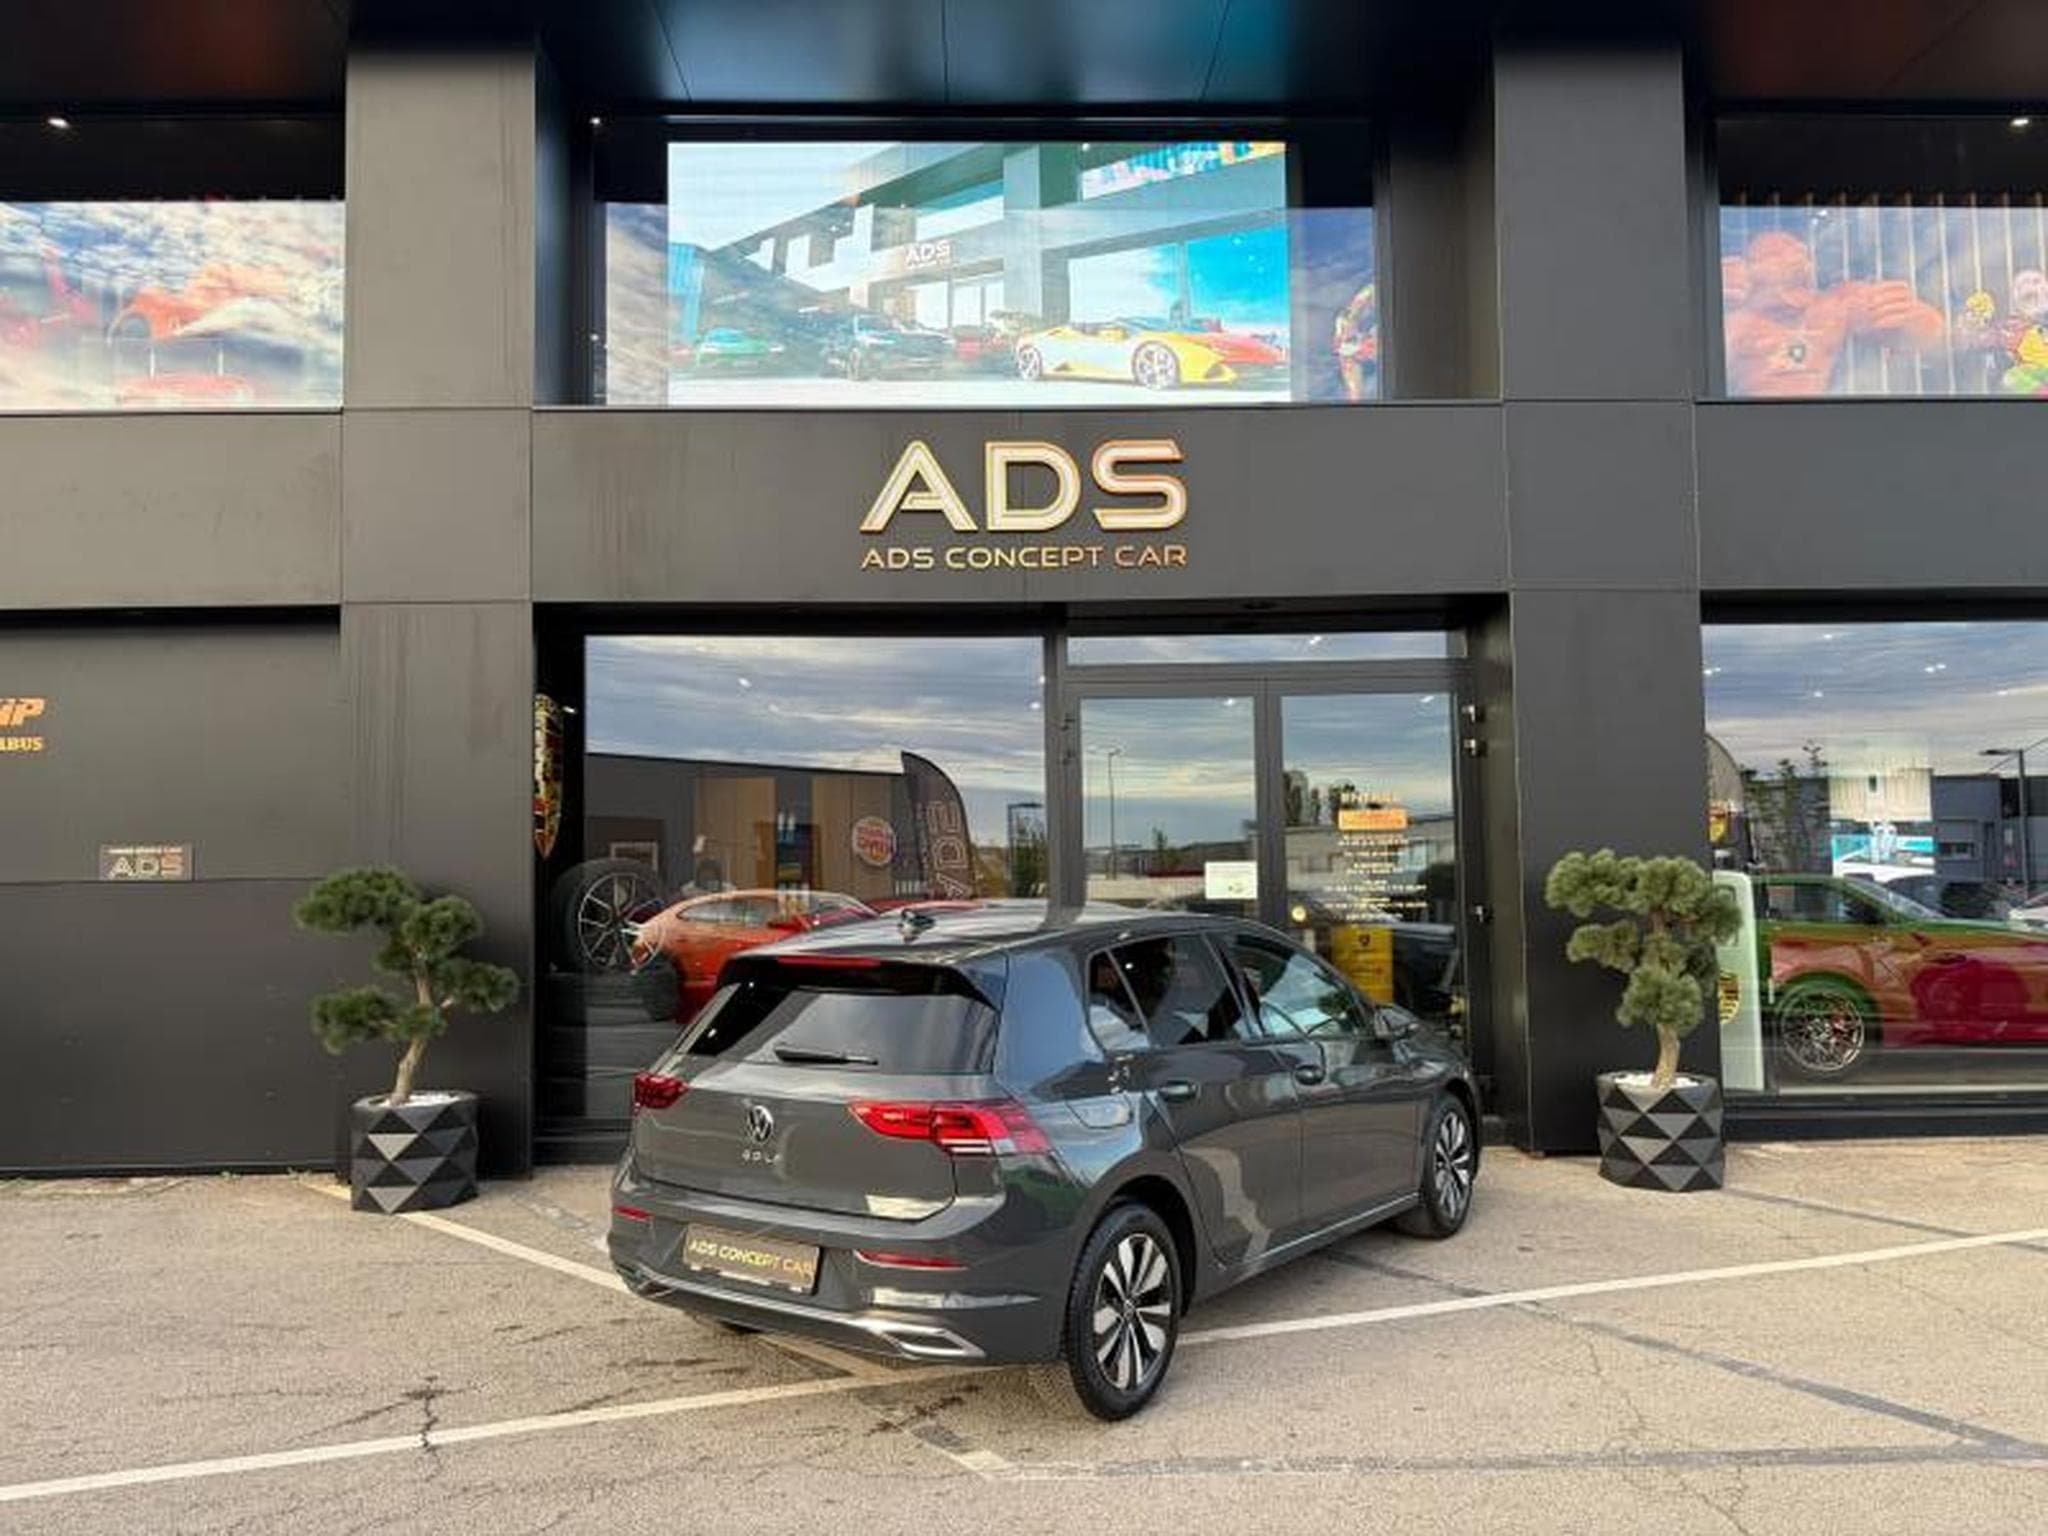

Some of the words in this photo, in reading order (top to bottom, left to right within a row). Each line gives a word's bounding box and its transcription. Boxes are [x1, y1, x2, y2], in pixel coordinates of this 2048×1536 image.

[859, 439, 1188, 532] ADS
[861, 547, 935, 569] ADS
[945, 546, 1104, 569] CONCEPT
[1114, 545, 1188, 567] CAR
[107, 856, 183, 880] ADS
[689, 1239, 718, 1257] ADS
[719, 1245, 780, 1268] CONCEPT
